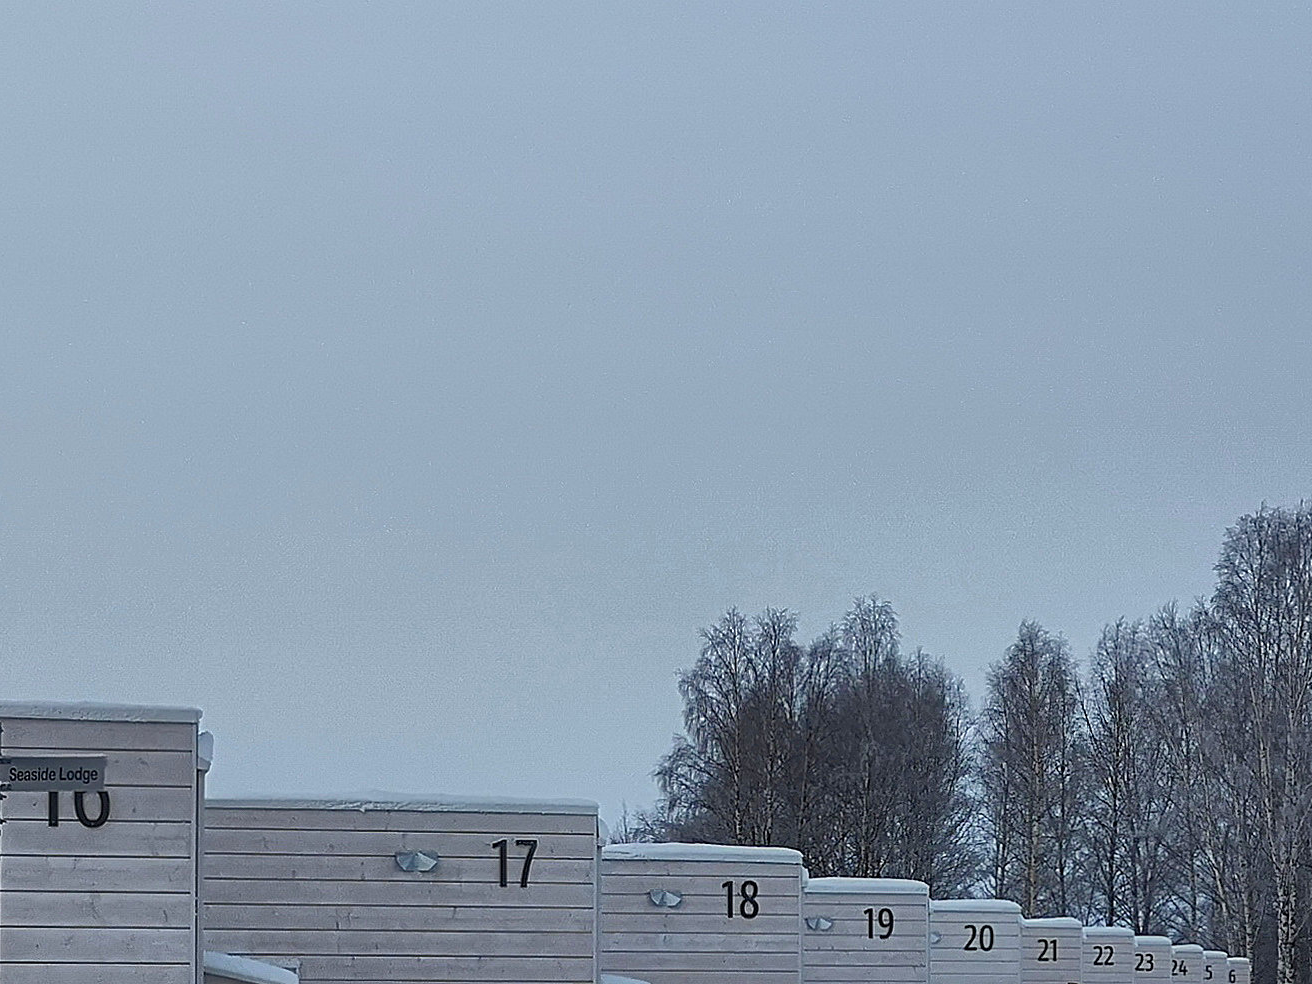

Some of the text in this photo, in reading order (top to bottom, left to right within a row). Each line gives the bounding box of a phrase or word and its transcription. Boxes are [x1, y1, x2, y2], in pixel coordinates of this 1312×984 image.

[9, 767, 99, 784] Seaside Lodge
[491, 839, 539, 888] 17
[721, 880, 760, 919] 18
[863, 907, 895, 940] 19
[963, 924, 995, 952] 20
[1037, 938, 1058, 962] 21
[1093, 945, 1115, 966] 22
[1134, 953, 1154, 972] 23
[1171, 959, 1188, 976] 24
